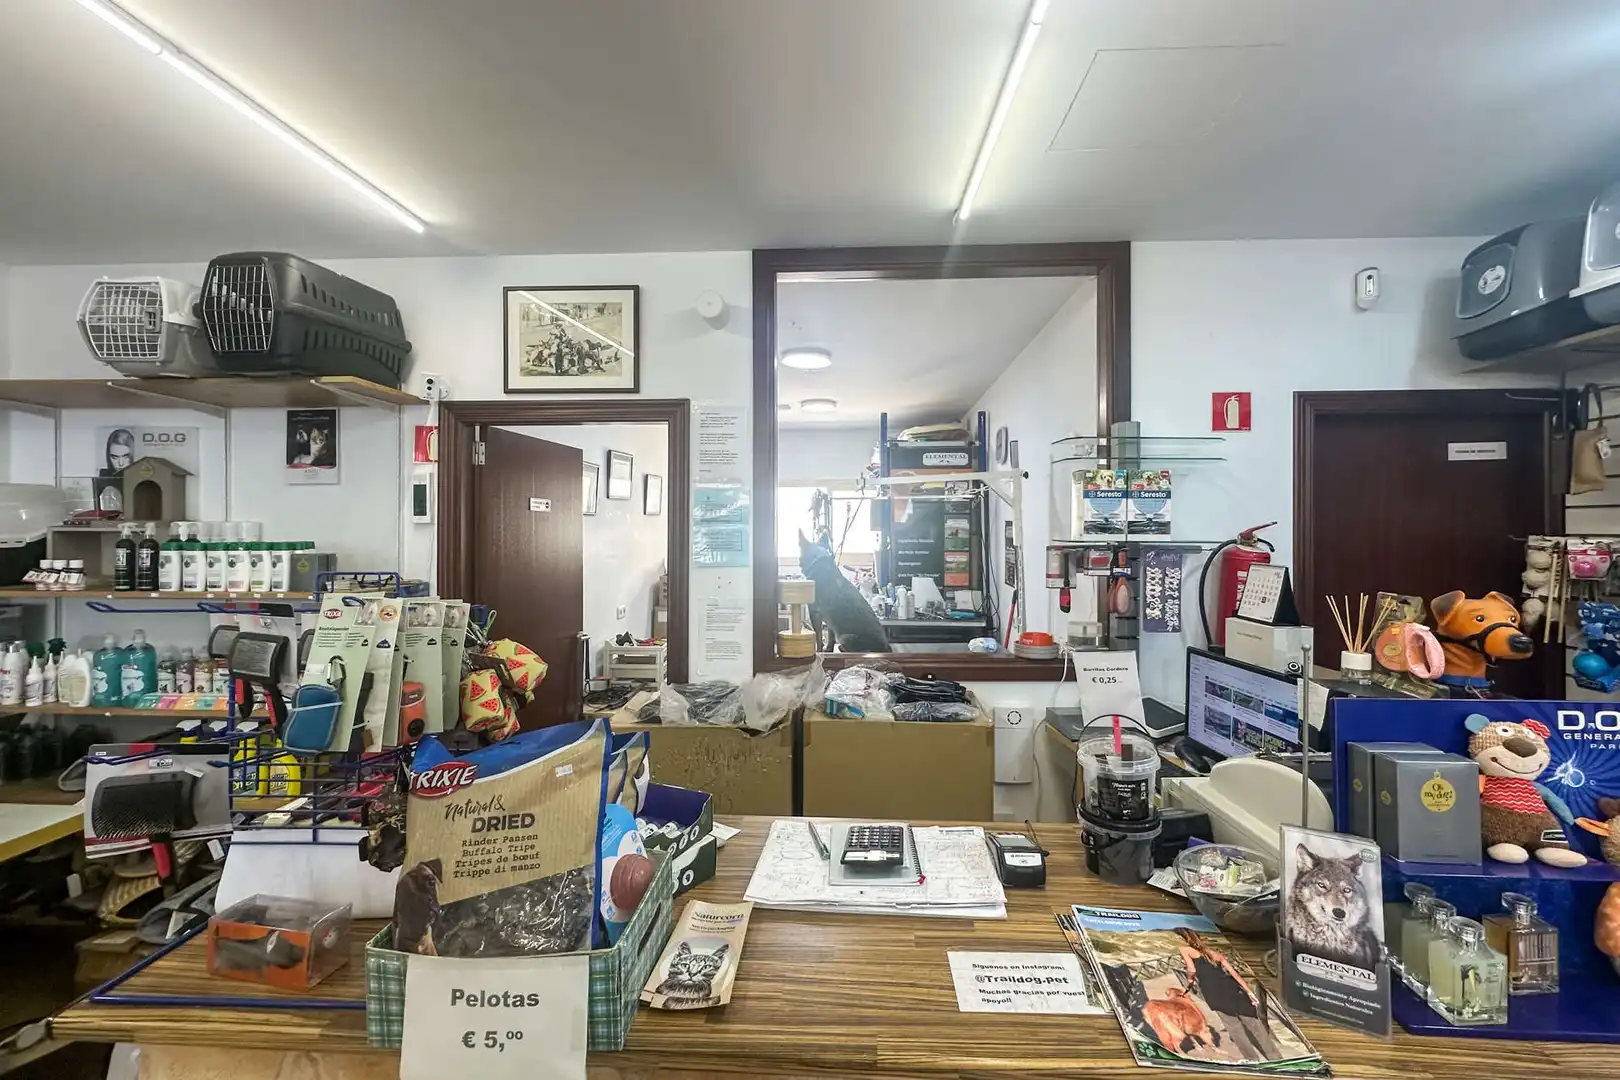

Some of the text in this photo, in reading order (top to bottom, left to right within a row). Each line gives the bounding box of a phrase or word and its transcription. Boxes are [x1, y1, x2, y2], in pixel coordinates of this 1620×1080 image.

[142, 433, 187, 443] D.O.G
[1092, 676, 1117, 684] € 0,25
[408, 764, 479, 791] TRIXIE
[471, 813, 536, 833] DRIED
[461, 834, 539, 848] Rinder Pansen
[462, 843, 536, 858] Buffalo Tripe
[455, 859, 493, 869] Tripes
[496, 856, 509, 865] de
[453, 862, 541, 879] Trippe di manzo
[1301, 956, 1376, 981] ELEMENTAL
[974, 974, 1070, 985] @Traildog.pet
[451, 988, 541, 1008] Pelotas
[979, 988, 1012, 996] Muchas
[1013, 989, 1045, 997] gracias
[461, 1030, 525, 1053] € 5,00
